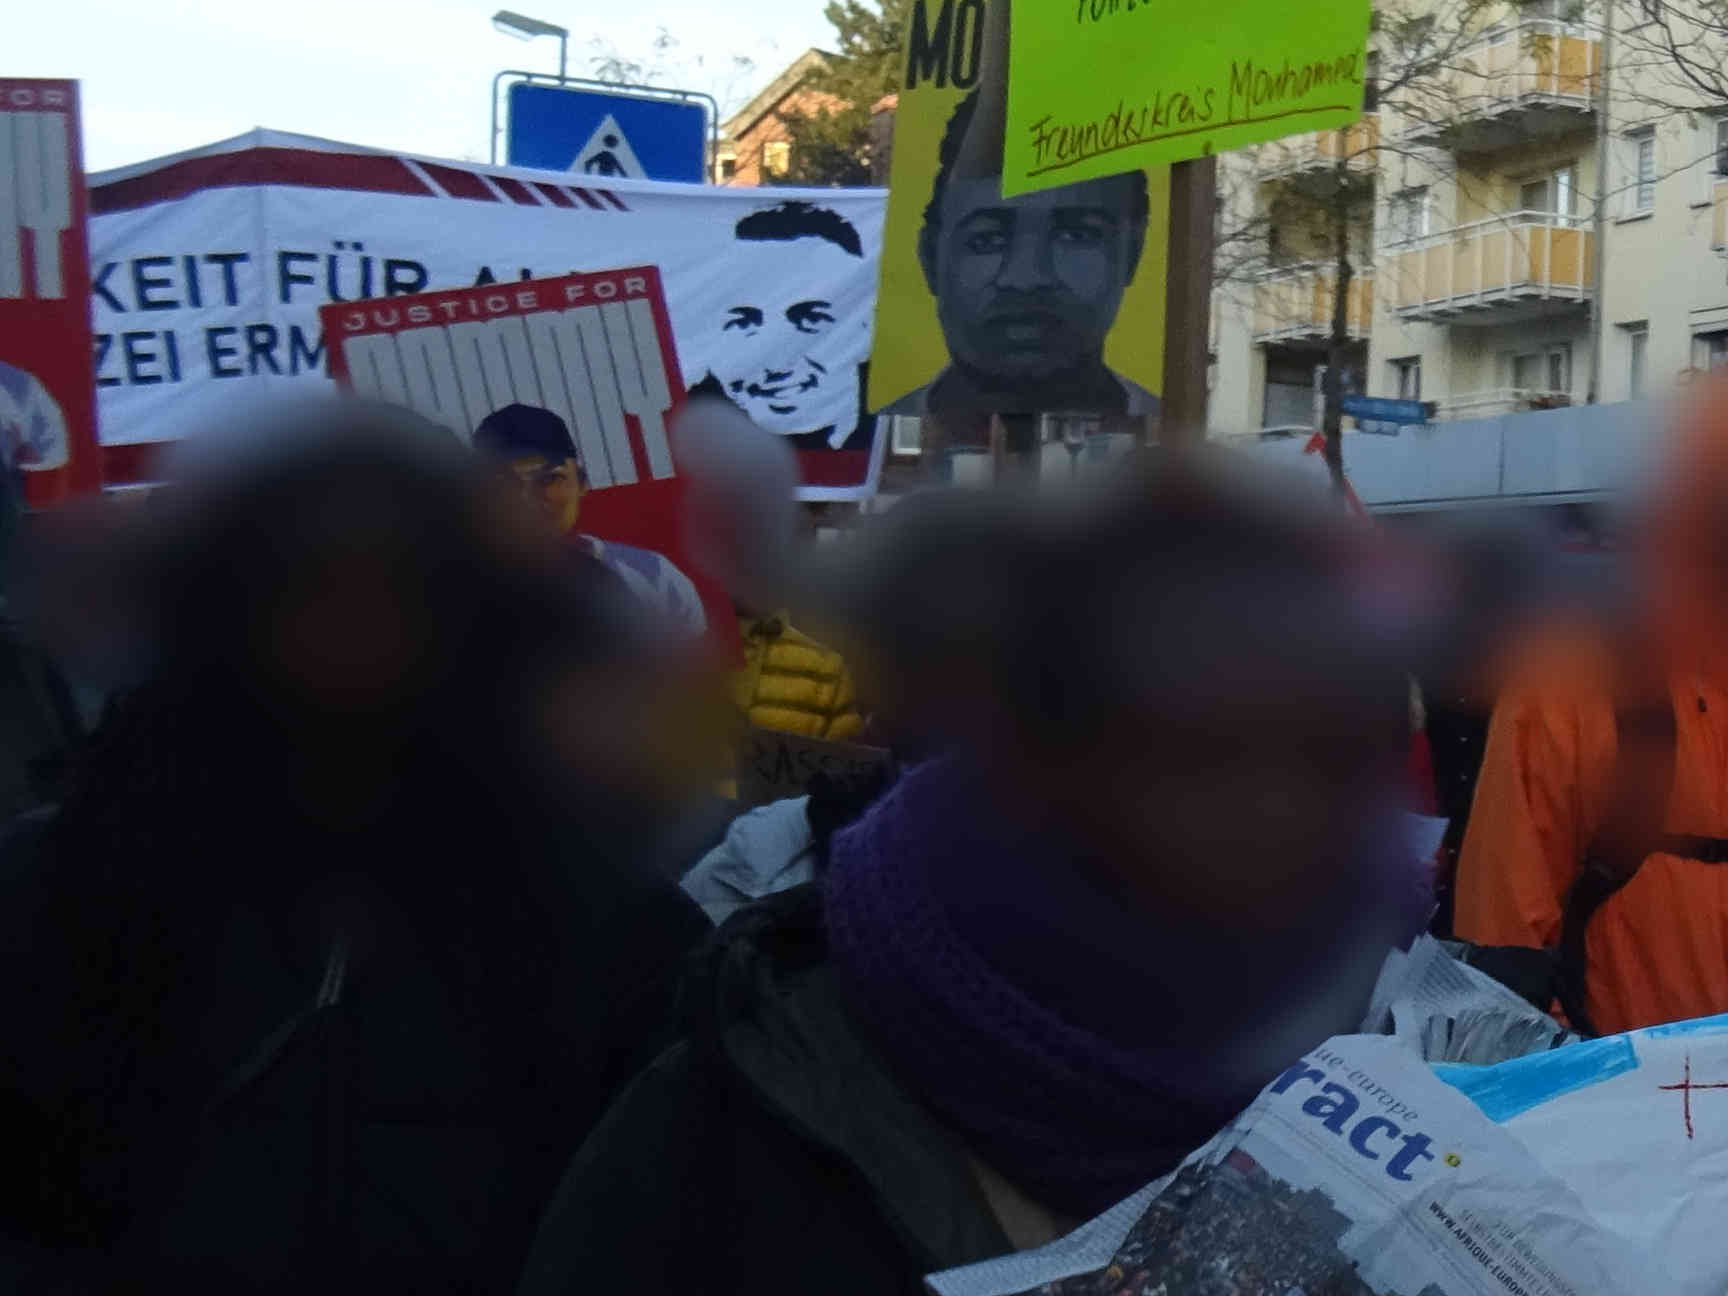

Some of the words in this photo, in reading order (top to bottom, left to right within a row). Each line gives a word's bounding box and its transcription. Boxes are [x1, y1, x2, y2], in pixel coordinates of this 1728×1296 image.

[0, 88, 66, 105] OR
[278, 241, 430, 304] FÜR
[344, 292, 540, 332] JUSTICE
[564, 277, 648, 302] FOR
